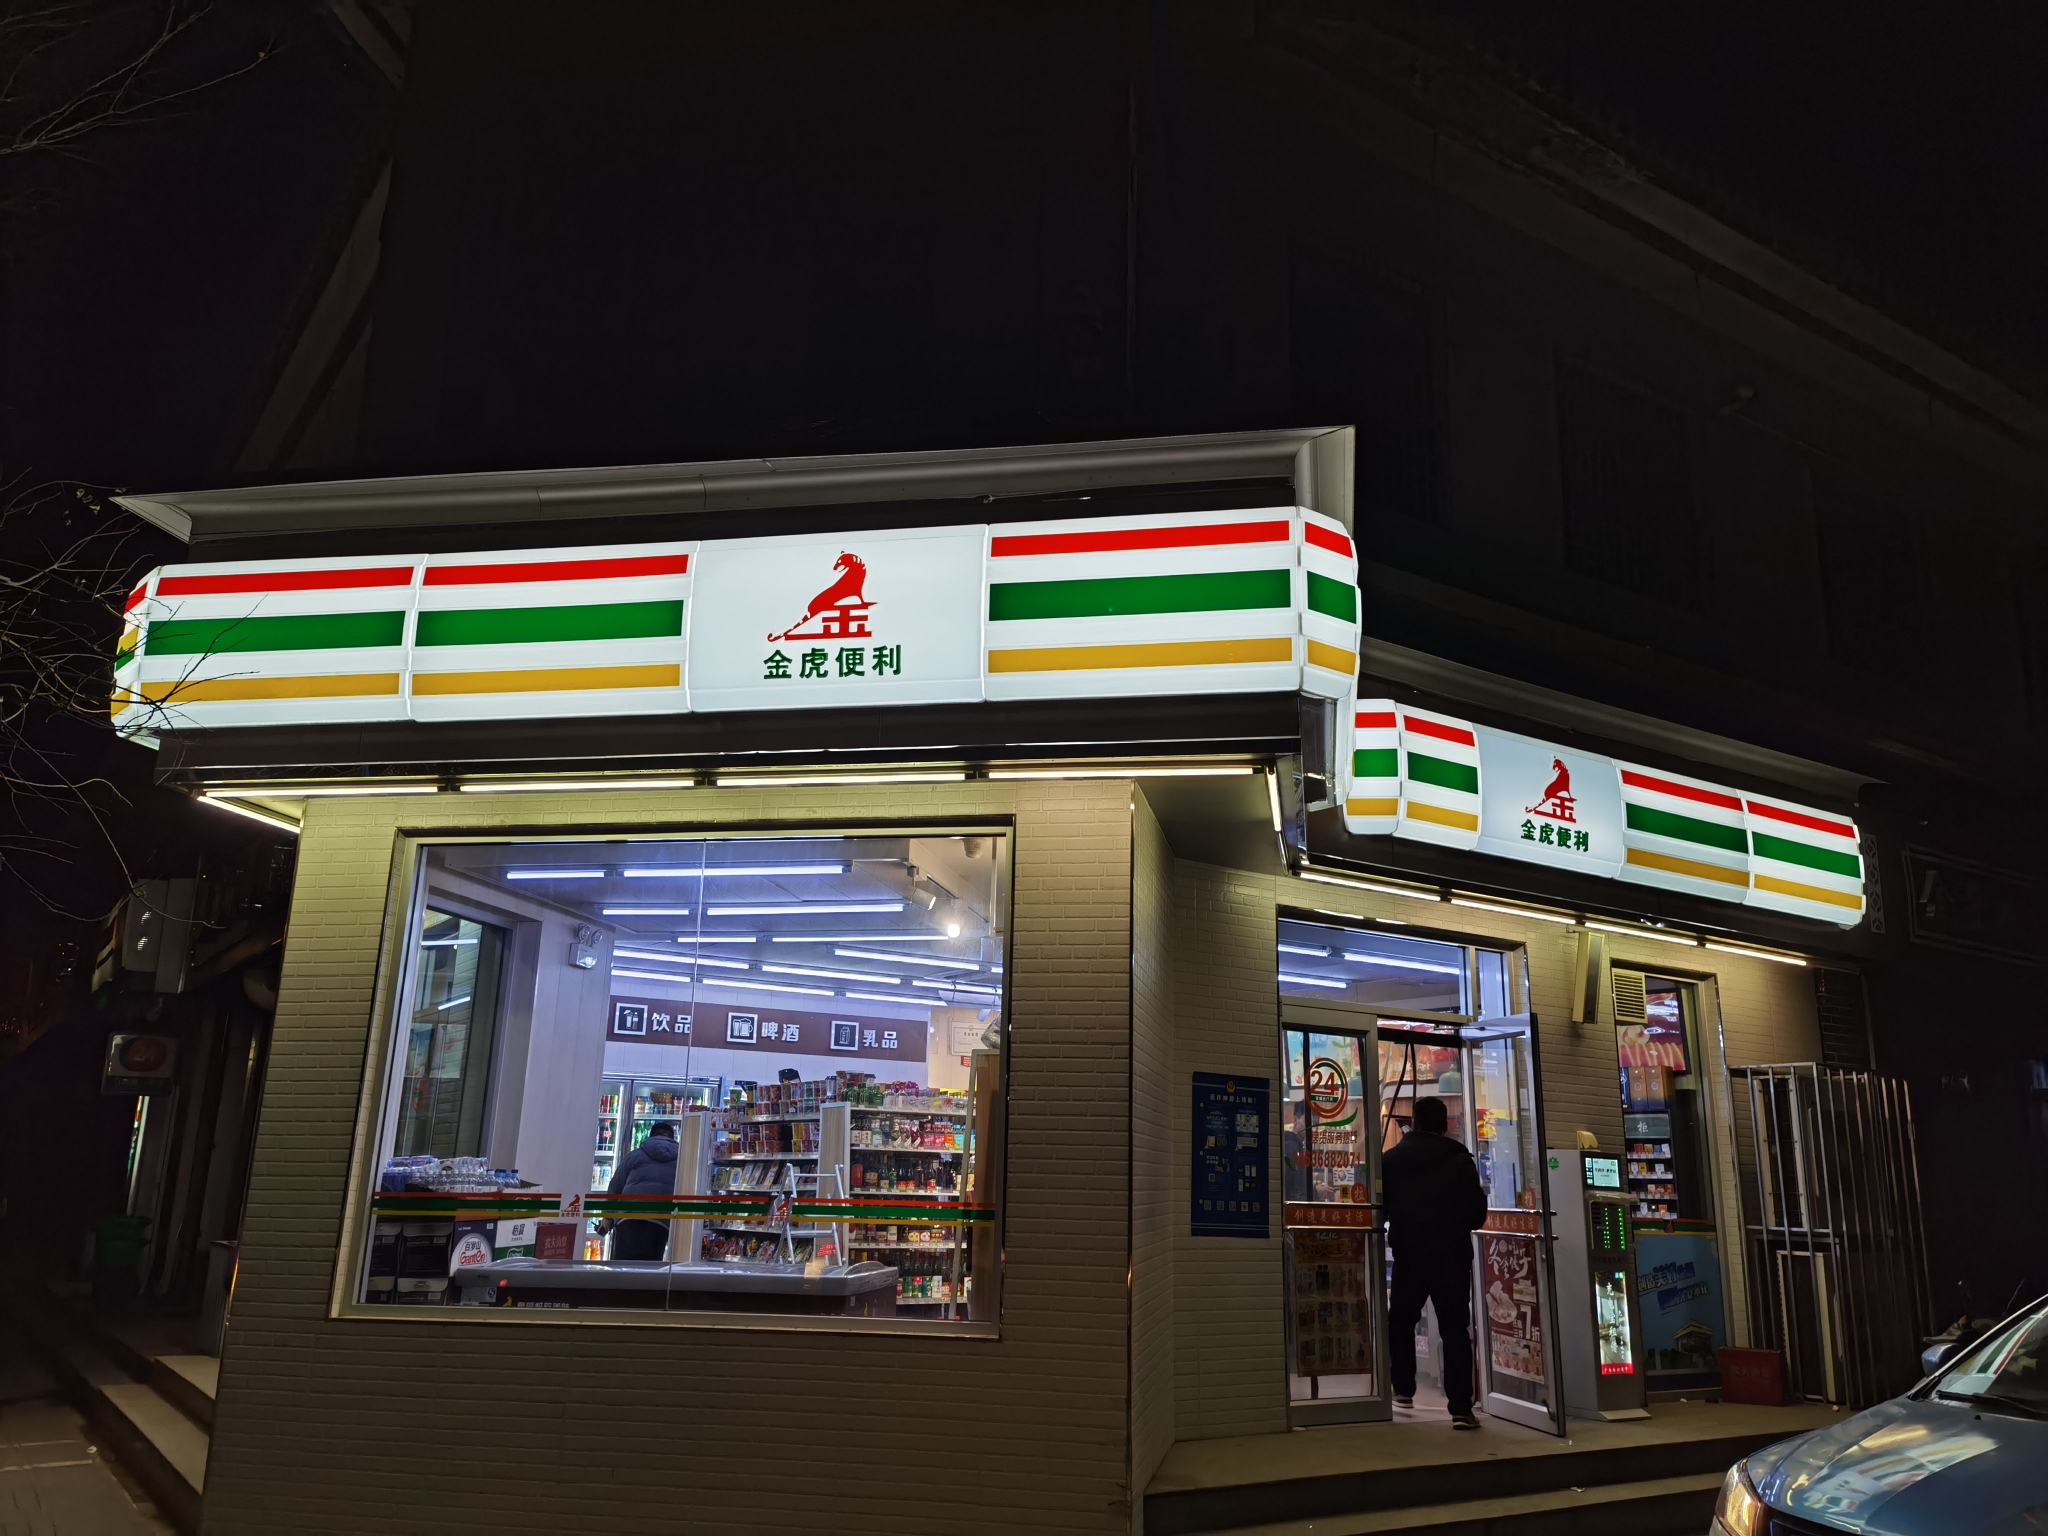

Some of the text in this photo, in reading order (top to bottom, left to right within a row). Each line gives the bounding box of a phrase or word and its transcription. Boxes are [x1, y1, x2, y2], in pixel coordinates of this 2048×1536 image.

[763, 644, 902, 680] 金虎便利
[1521, 818, 1589, 853] 金虎便利
[651, 1012, 692, 1034] 饮品
[761, 1021, 801, 1042] 啤酒
[862, 1029, 899, 1049] 乳品
[1310, 1070, 1340, 1096] 24
[1354, 1185, 1366, 1201] 拉
[1293, 1208, 1364, 1224] 创造美好生活
[464, 1241, 481, 1252] 百岁山
